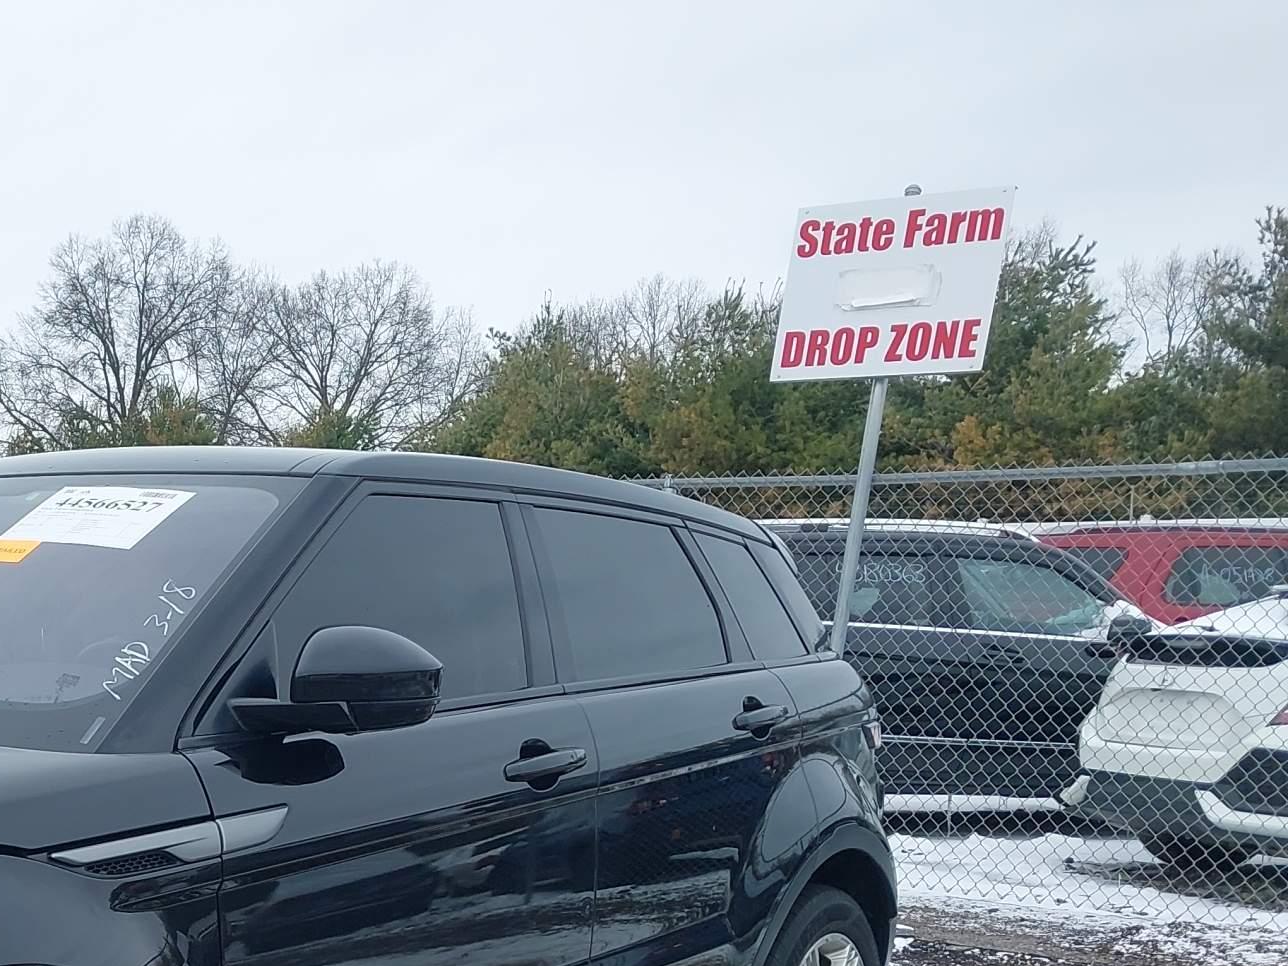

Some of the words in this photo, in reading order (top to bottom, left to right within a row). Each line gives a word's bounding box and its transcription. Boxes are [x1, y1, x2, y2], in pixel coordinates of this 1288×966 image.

[796, 215, 896, 259] State
[903, 207, 1005, 249] Farm
[780, 326, 880, 369] DROP
[884, 318, 982, 363] ZONE
[55, 497, 165, 513] 44566527
[102, 641, 150, 700] MAD
[143, 579, 196, 635] 3-18
